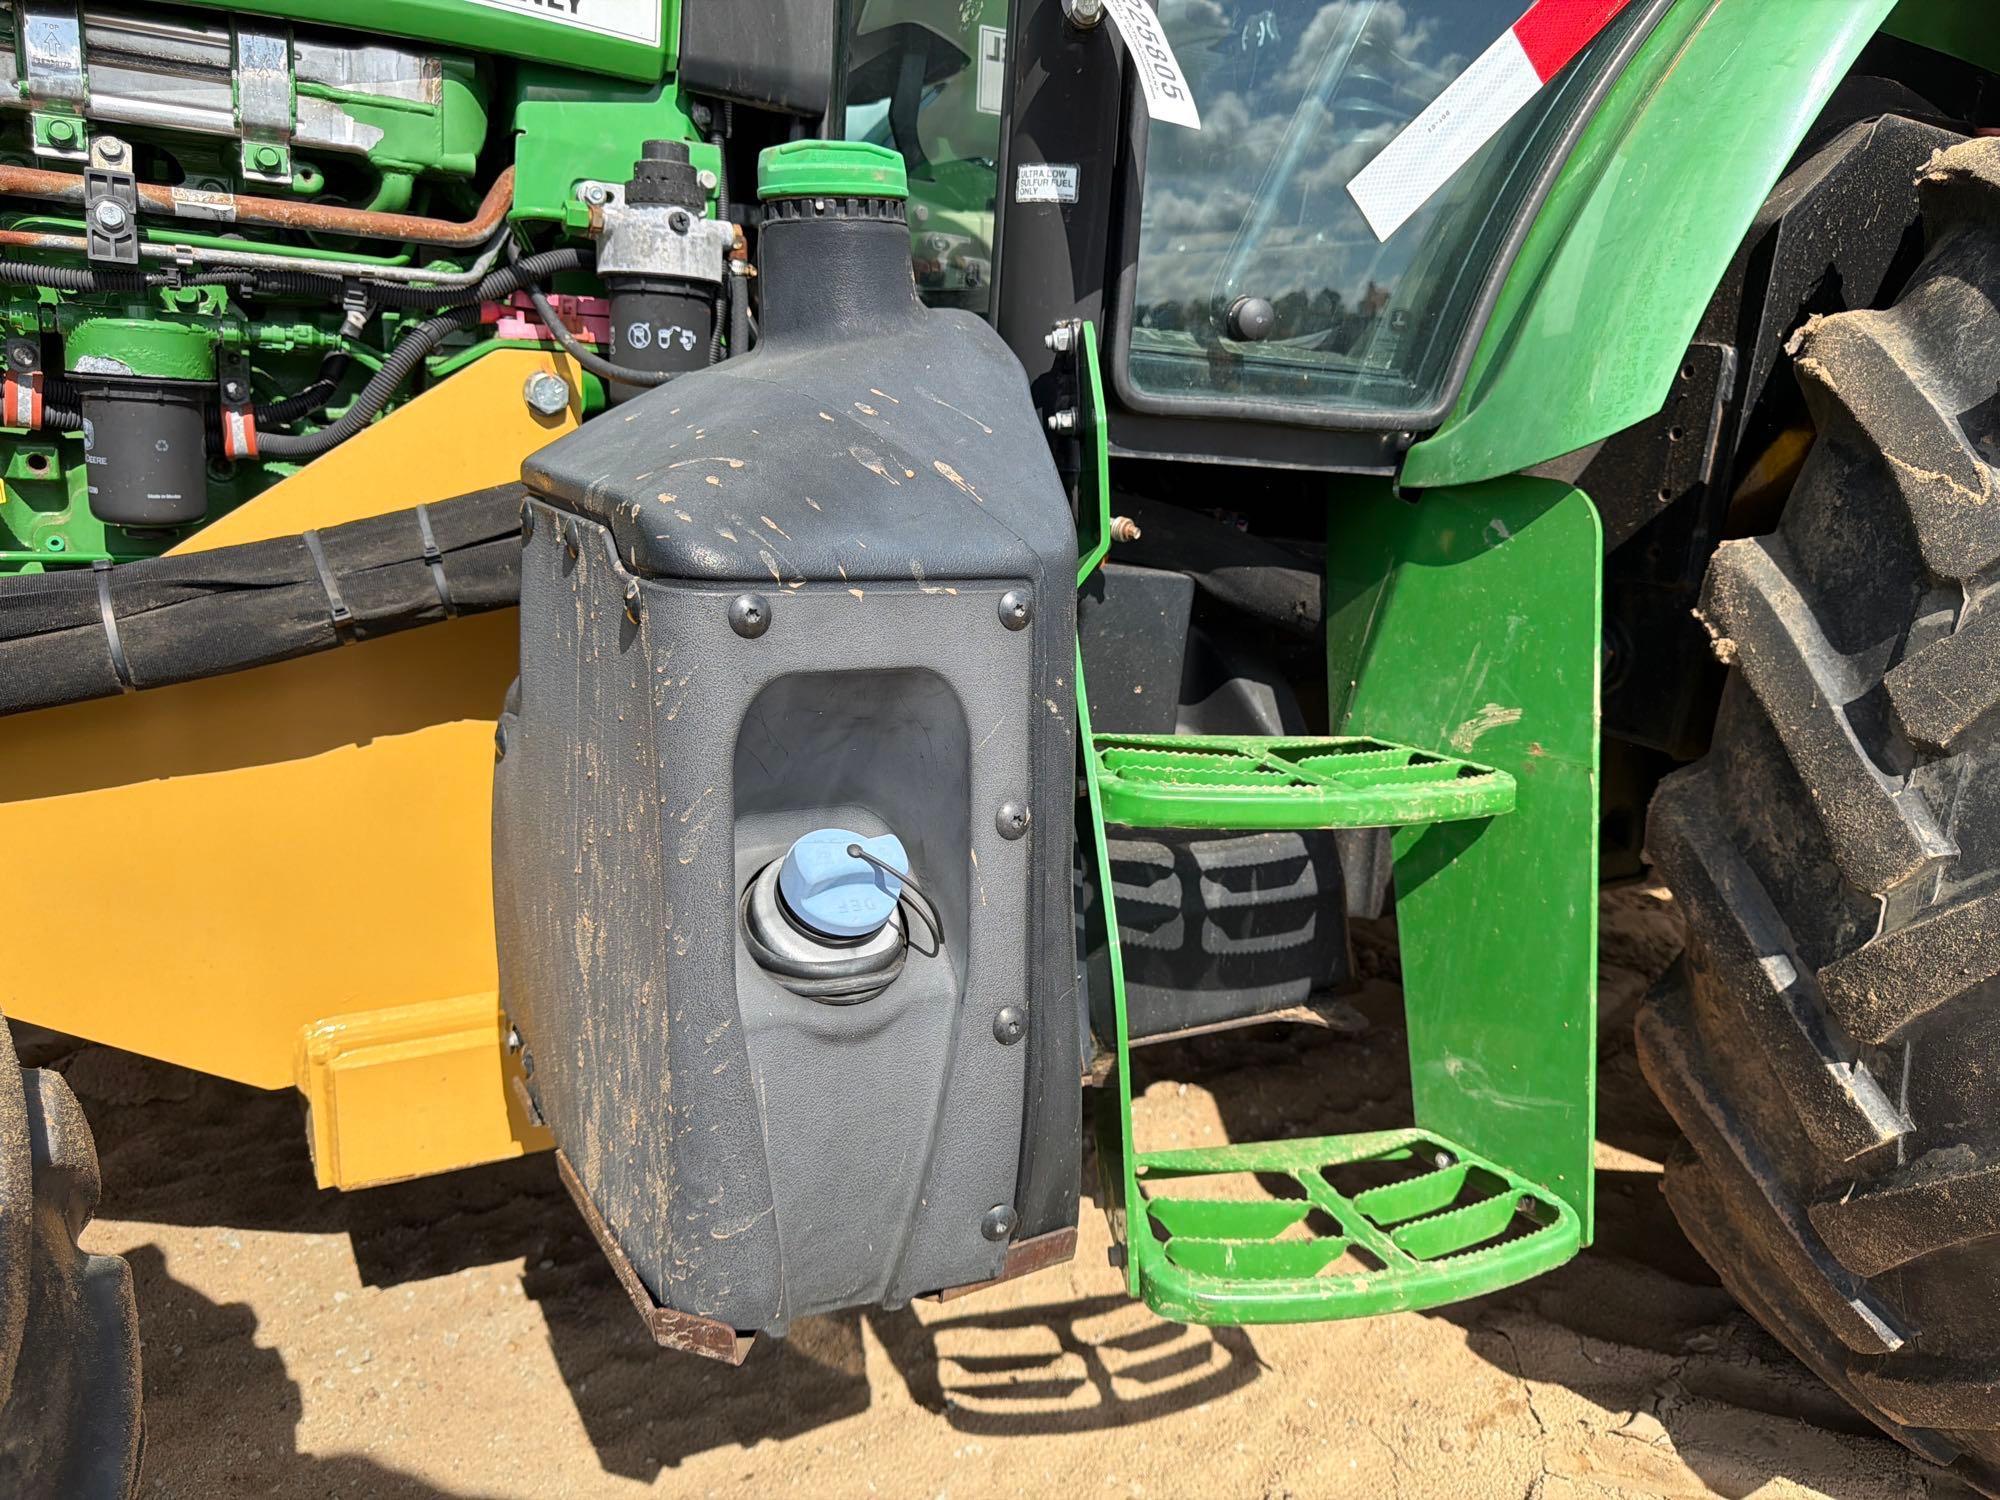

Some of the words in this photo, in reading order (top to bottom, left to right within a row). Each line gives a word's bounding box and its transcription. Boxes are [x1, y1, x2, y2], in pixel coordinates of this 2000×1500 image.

[1021, 169, 1044, 179] ULTRA
[1047, 170, 1067, 178] LOW
[1020, 179, 1048, 187] SULFUR
[1052, 179, 1073, 188] FUEL
[1020, 187, 1038, 195] ONLY
[85, 454, 107, 464] DEERE
